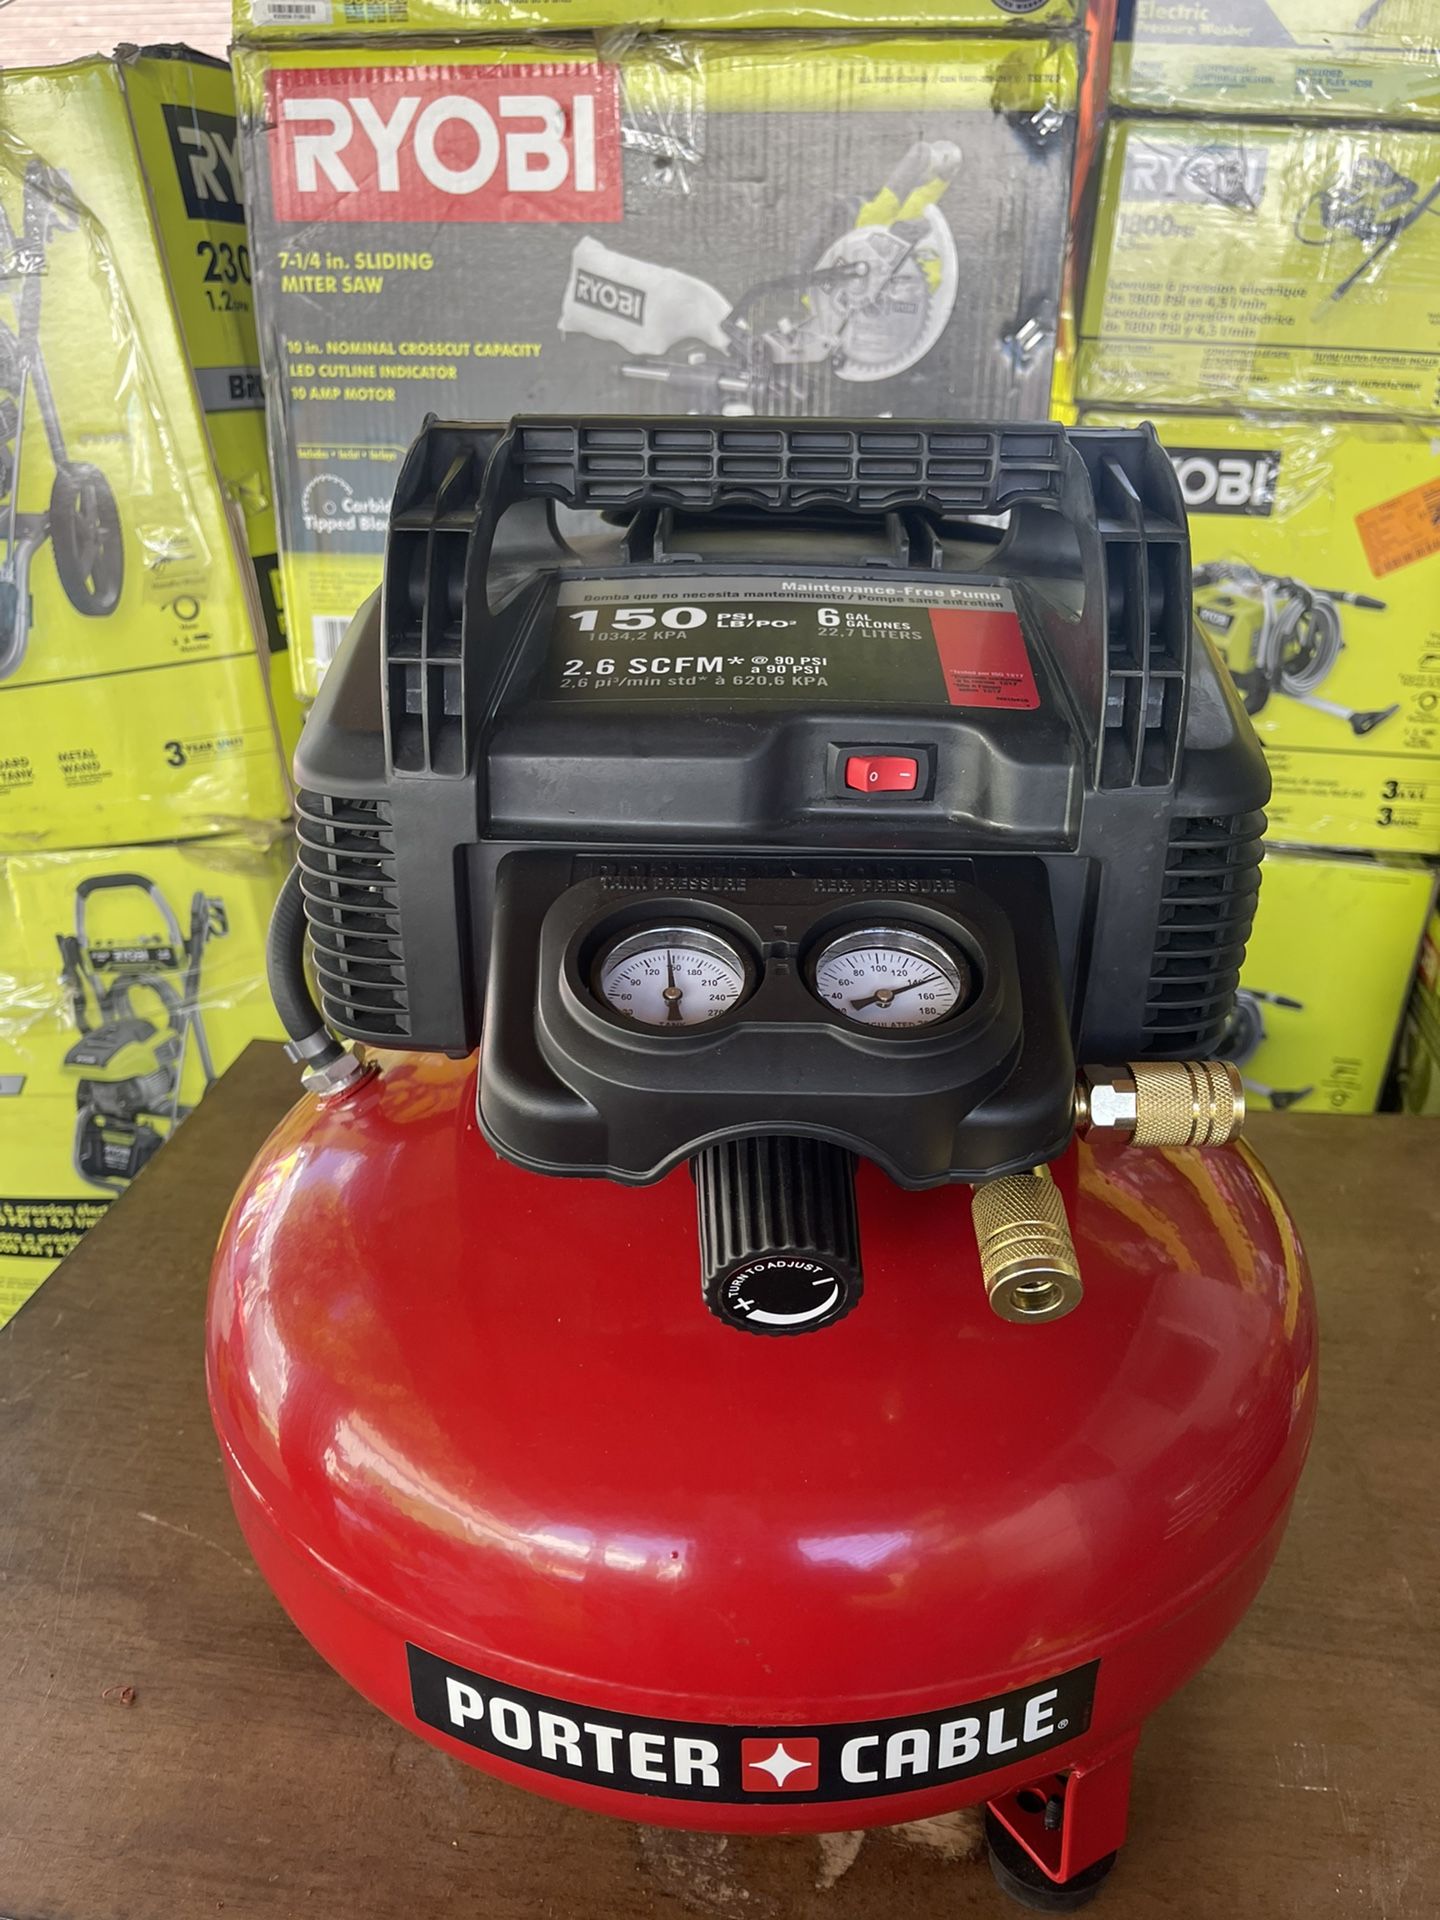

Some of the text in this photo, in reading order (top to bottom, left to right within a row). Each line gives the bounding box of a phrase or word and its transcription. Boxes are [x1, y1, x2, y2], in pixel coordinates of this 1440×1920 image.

[284, 95, 596, 194] RYOBI
[1133, 154, 1259, 198] RYOI
[278, 252, 434, 271] 7-1/4 in. SLIDING
[281, 276, 384, 294] MITER SAW
[576, 272, 642, 320] RYOBI
[287, 340, 302, 355] 10
[326, 341, 396, 356] NOMINAL
[398, 341, 470, 356] CROSSCUT
[473, 342, 542, 357] CAPACITY
[289, 364, 458, 379] LED CUTLINE INDICATOR
[291, 387, 396, 401] 10 AMP MOTOR
[1173, 457, 1269, 506] OBI
[303, 513, 388, 533] Tipped Bla
[583, 593, 629, 602] Bomba
[634, 593, 658, 601] que
[683, 590, 740, 599] necesita
[743, 590, 845, 601] mantenimiento
[858, 594, 904, 604] Pompe
[908, 596, 939, 605] sans
[943, 597, 1004, 609] entretien
[781, 582, 1001, 602] Maintenance-Free Pump
[569, 606, 753, 632] 150 PSI
[817, 607, 872, 627] 6 GAL
[846, 620, 911, 630] GALONES
[589, 631, 687, 642] 1034,2 KPA
[861, 629, 923, 641] LITERS
[563, 658, 616, 676] 2.6
[751, 656, 769, 665] @
[774, 656, 795, 665] 90
[800, 656, 827, 666] PSI
[767, 665, 786, 674] 90
[792, 665, 820, 675] PSI
[560, 678, 588, 689] 2,6
[715, 674, 725, 686] à
[733, 675, 785, 687] 620,6
[792, 676, 828, 686] KPA
[164, 741, 187, 766] 3
[1382, 779, 1399, 800] 3
[1376, 806, 1394, 826] 3
[600, 876, 747, 892] TANK PRESSURE
[862, 879, 957, 893] PRESSURE
[644, 968, 660, 976] 120
[687, 968, 703, 976] 180
[853, 969, 864, 977] 80
[870, 965, 887, 973] 100
[891, 969, 908, 977] 120
[630, 979, 642, 987] 90
[701, 979, 718, 987] 210
[838, 979, 849, 987] 60
[621, 993, 632, 1001] 60
[709, 993, 726, 1001] 240
[831, 992, 843, 1000] 40
[918, 992, 935, 1001] 160
[919, 1007, 937, 1015] 180
[728, 1260, 823, 1298] TURN TO ADJUST
[444, 1675, 720, 1788] PORTER
